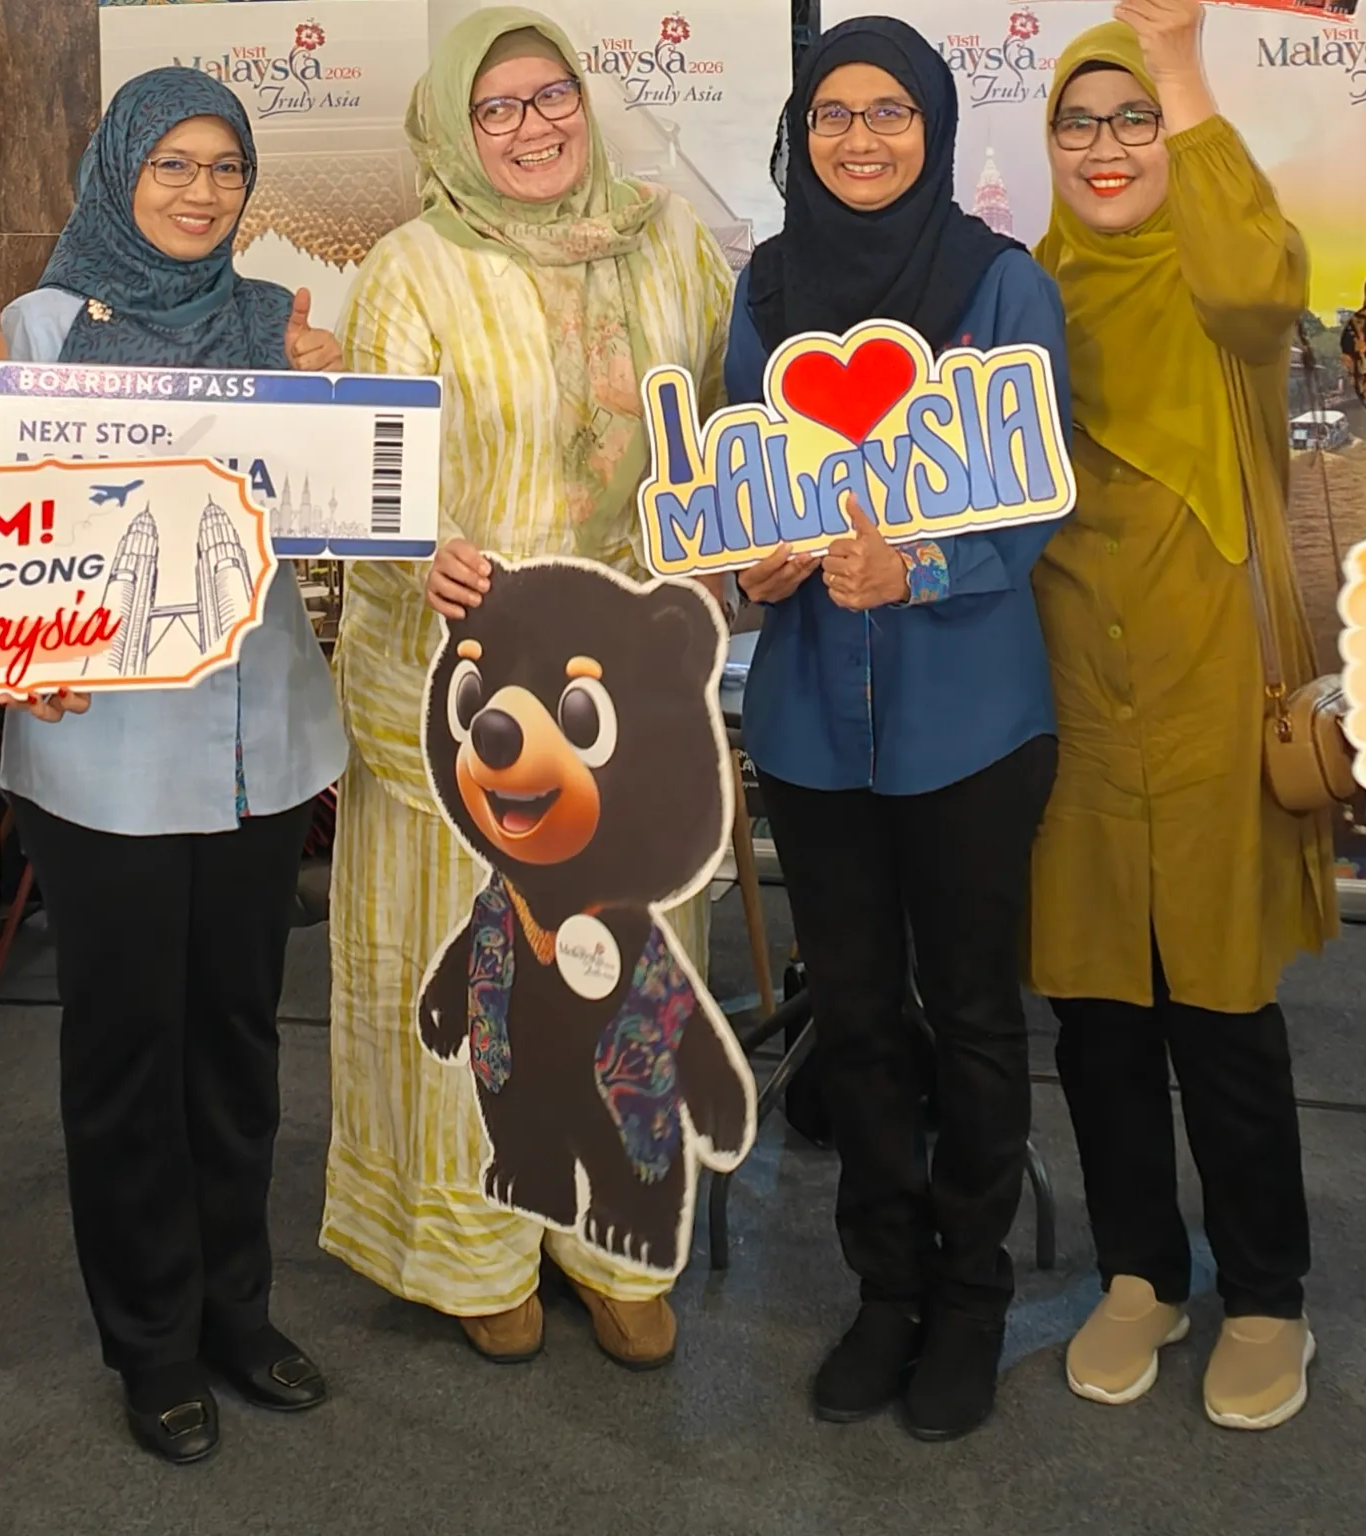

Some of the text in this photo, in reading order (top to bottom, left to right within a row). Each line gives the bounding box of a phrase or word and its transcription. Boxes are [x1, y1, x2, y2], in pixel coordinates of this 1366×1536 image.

[602, 38, 633, 50] Visit
[947, 35, 980, 46] Visit
[1322, 28, 1360, 40] Visit
[232, 46, 267, 58] Visit
[577, 41, 724, 81] alaysia 2026
[324, 67, 362, 80] 2026
[257, 86, 360, 119] Truly Asia
[623, 77, 723, 110] Truly Asia
[970, 75, 1029, 108] Truly
[18, 365, 256, 398] BOARDING PASS
[19, 420, 173, 446] NEXT STOP:
[657, 382, 693, 485] I
[654, 363, 1057, 562] MALAYSIA
